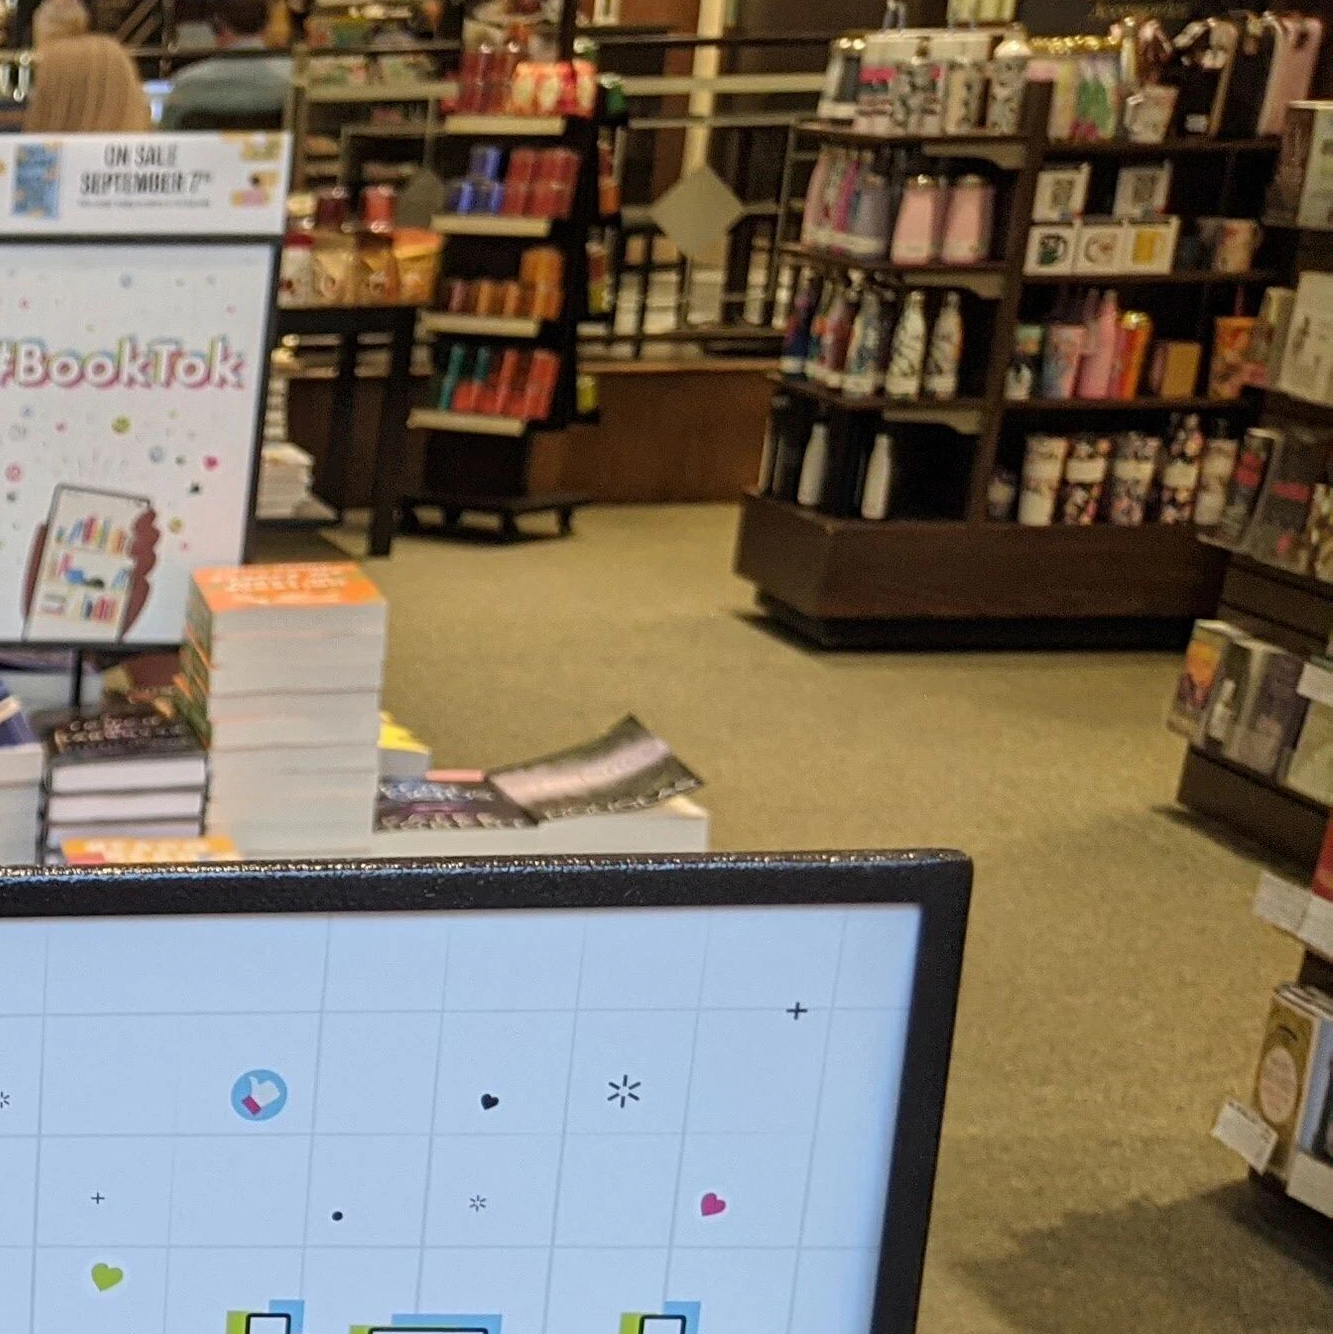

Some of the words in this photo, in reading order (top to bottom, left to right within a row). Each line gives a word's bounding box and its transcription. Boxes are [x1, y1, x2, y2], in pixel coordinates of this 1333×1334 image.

[104, 144, 129, 167] ON
[134, 142, 179, 166] SALE
[79, 170, 185, 196] SEPTEMBER
